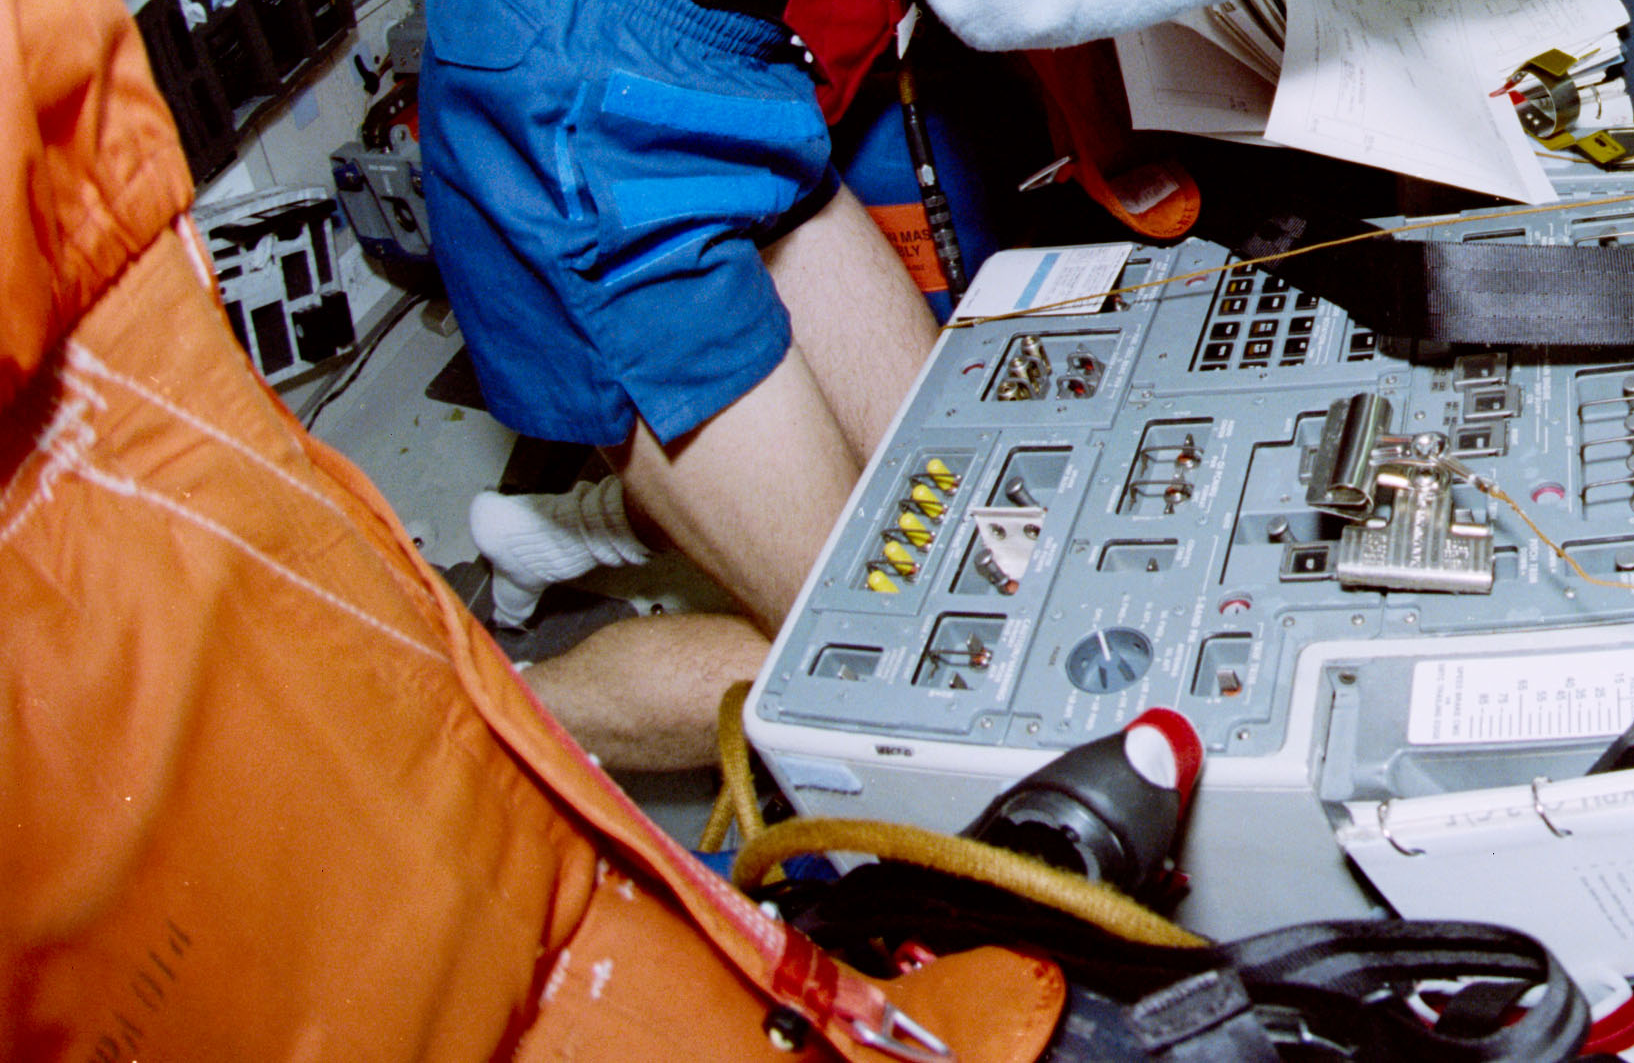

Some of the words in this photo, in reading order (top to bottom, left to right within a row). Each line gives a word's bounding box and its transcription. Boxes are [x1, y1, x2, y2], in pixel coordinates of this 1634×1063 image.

[900, 229, 931, 243] MAS
[1191, 595, 1207, 628] S-BAND
[1565, 677, 1574, 688] 40
[1614, 673, 1624, 684] 15
[1536, 691, 1545, 702] 55
[1594, 687, 1604, 698] 25
[1497, 693, 1506, 704] 75
[1453, 692, 1463, 717] BRAKE
